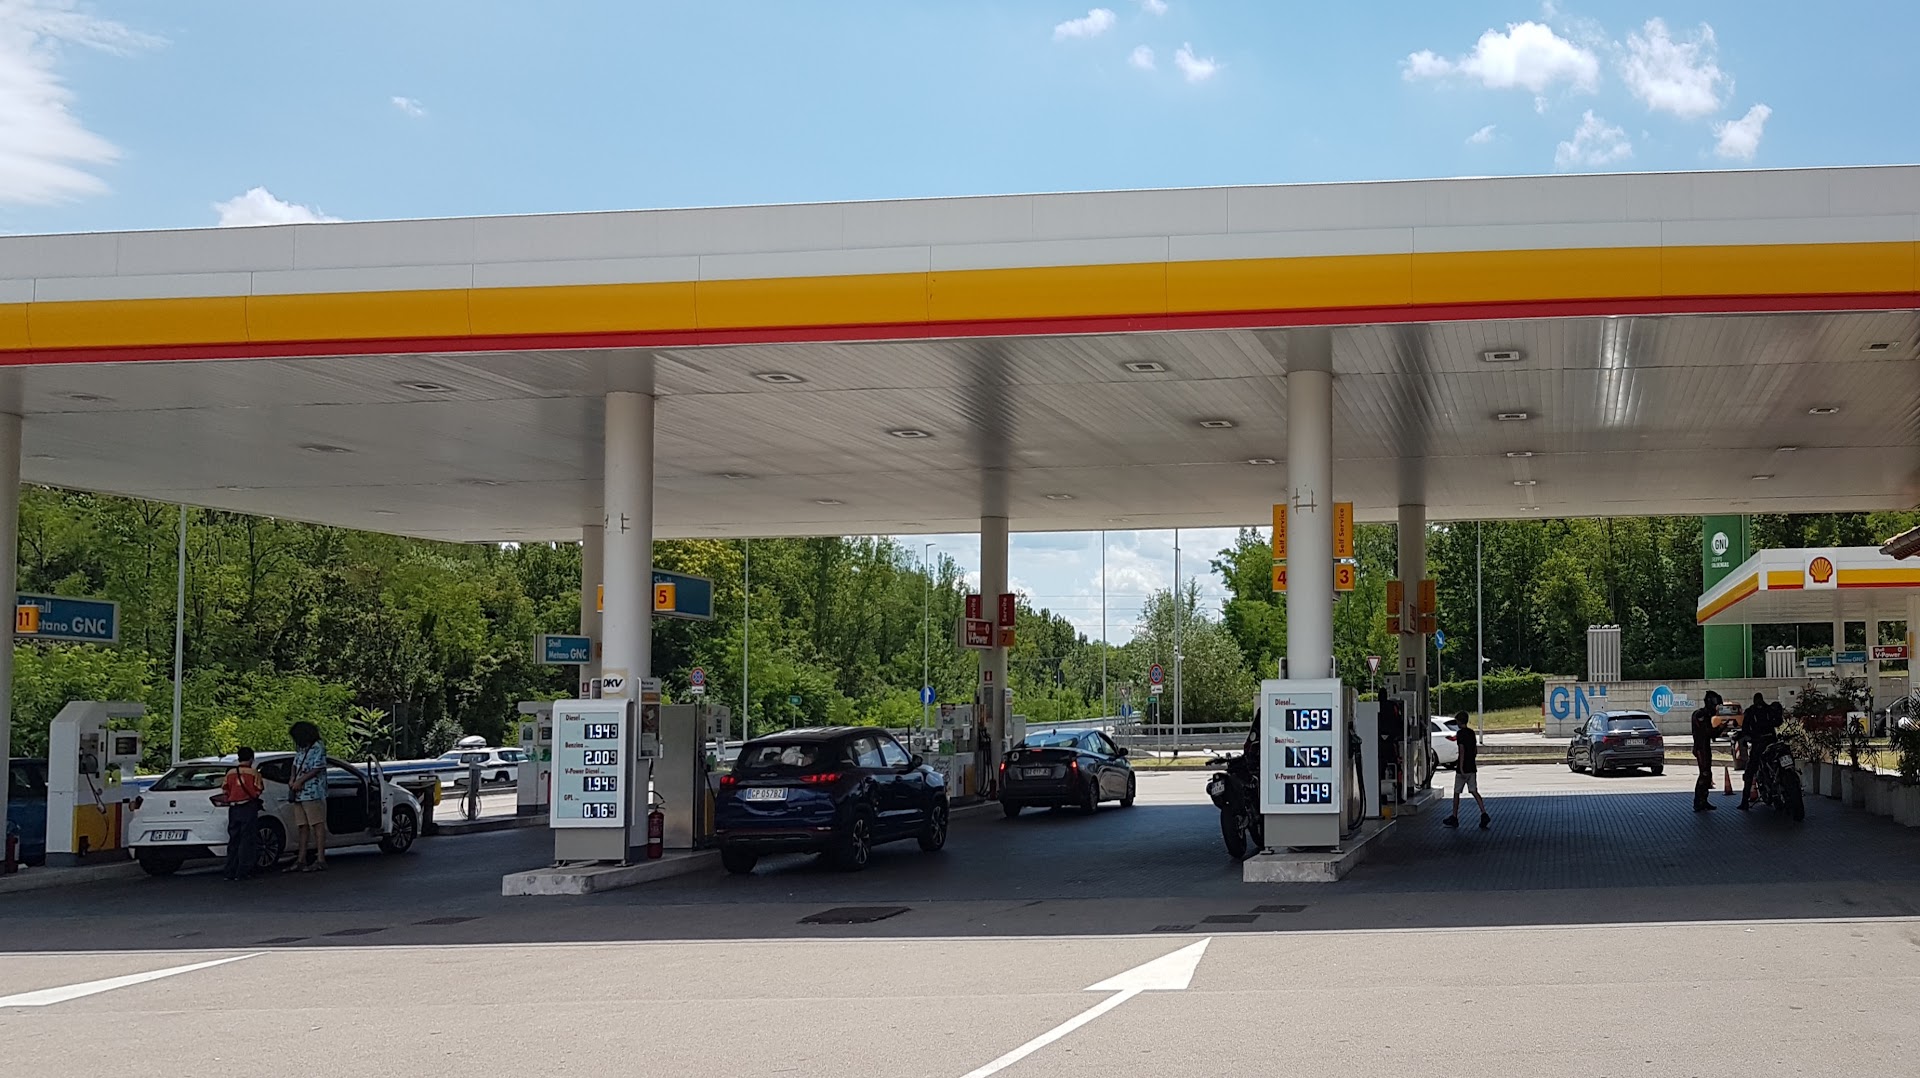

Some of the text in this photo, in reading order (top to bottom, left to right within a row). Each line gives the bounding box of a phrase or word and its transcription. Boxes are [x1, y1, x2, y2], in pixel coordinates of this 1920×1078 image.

[1715, 539, 1727, 550] GNL
[1277, 571, 1287, 585] 4
[1340, 569, 1349, 584] 3
[658, 590, 667, 604] 5
[18, 612, 30, 626] 11
[72, 617, 107, 634] GNC
[1002, 633, 1008, 643] 7
[570, 648, 588, 660] GNC
[603, 679, 623, 688] DKV
[1656, 694, 1673, 708] GNL
[1293, 710, 1329, 730] 1.699
[589, 724, 618, 739] 1.949
[585, 751, 617, 765] 2.009
[1293, 747, 1329, 767] 1.759
[588, 777, 616, 791] 1.949
[1293, 783, 1329, 804] 1.949
[583, 804, 616, 818] 0.769
